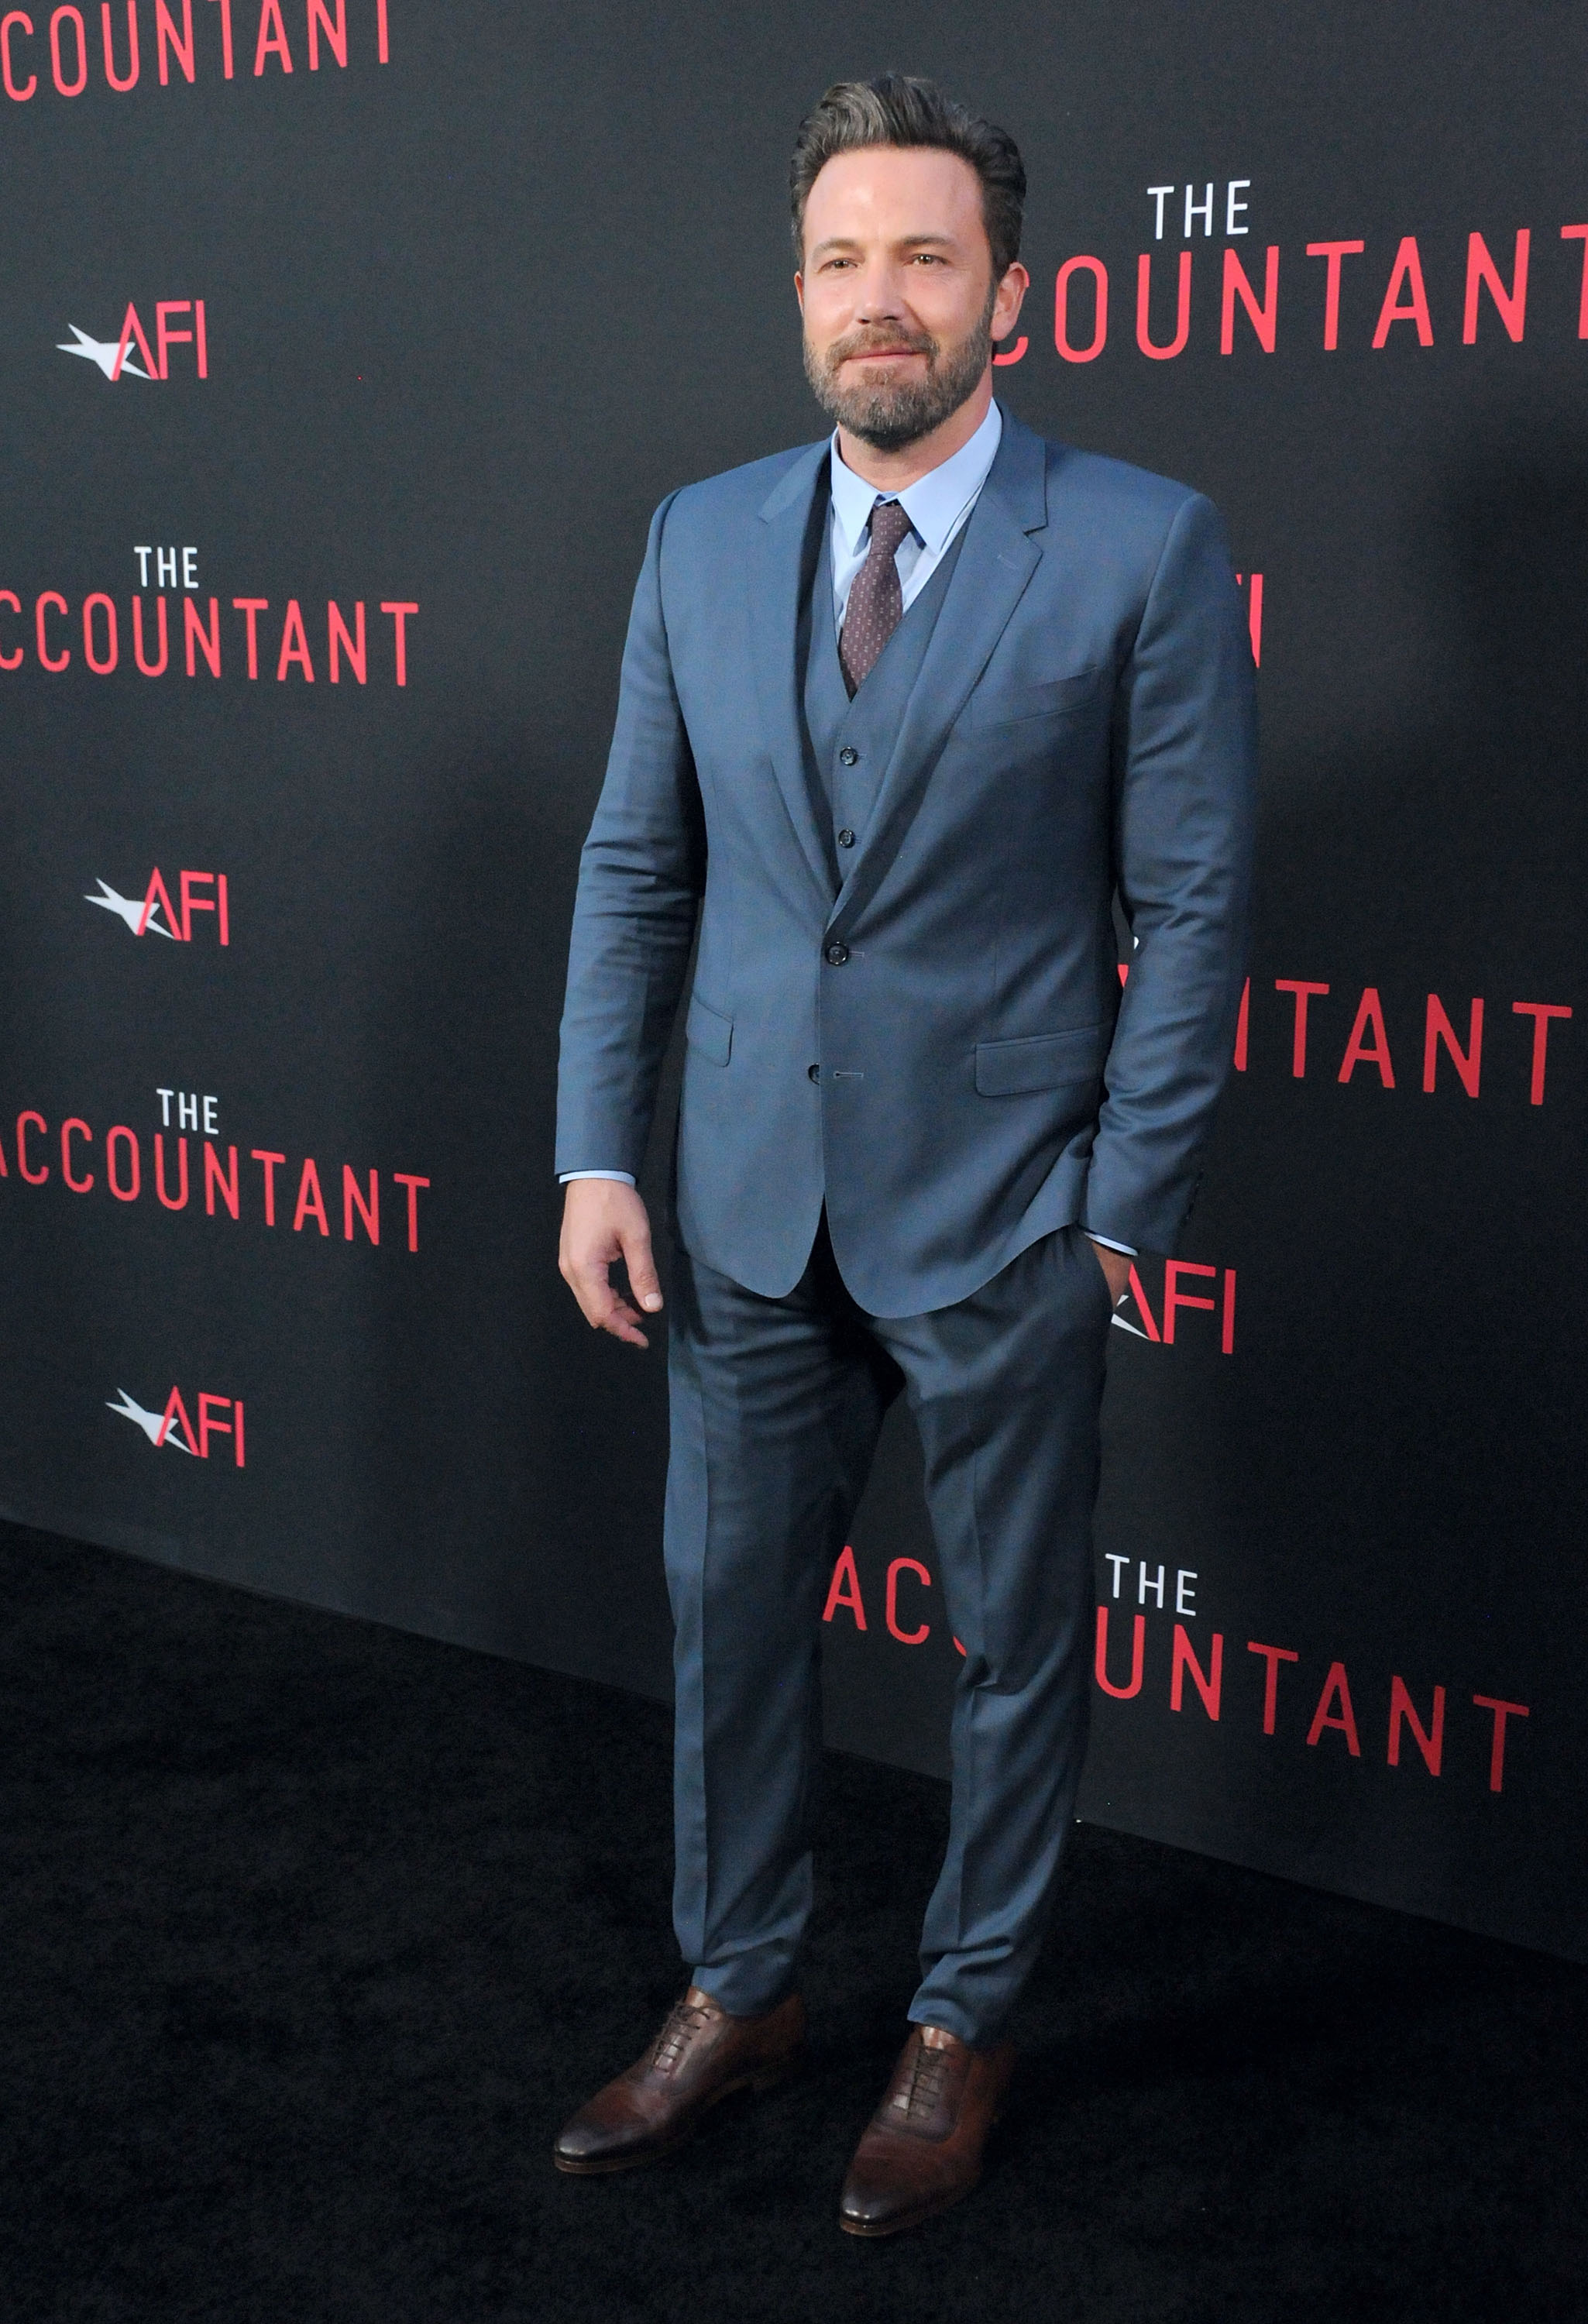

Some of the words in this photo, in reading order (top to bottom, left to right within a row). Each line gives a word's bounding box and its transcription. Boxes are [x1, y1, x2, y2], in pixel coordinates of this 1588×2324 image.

[1146, 179, 1253, 240] THE
[112, 299, 209, 382] AFI
[133, 546, 200, 590] THE
[0, 590, 420, 687] CCOUNTANT
[136, 866, 230, 947] AFI
[156, 1088, 220, 1136] THE
[0, 1110, 431, 1253] CCOUNTANT
[155, 1384, 246, 1468] AFI
[1105, 1552, 1198, 1618] THE
[822, 1545, 1529, 1793] ACUNTANT
